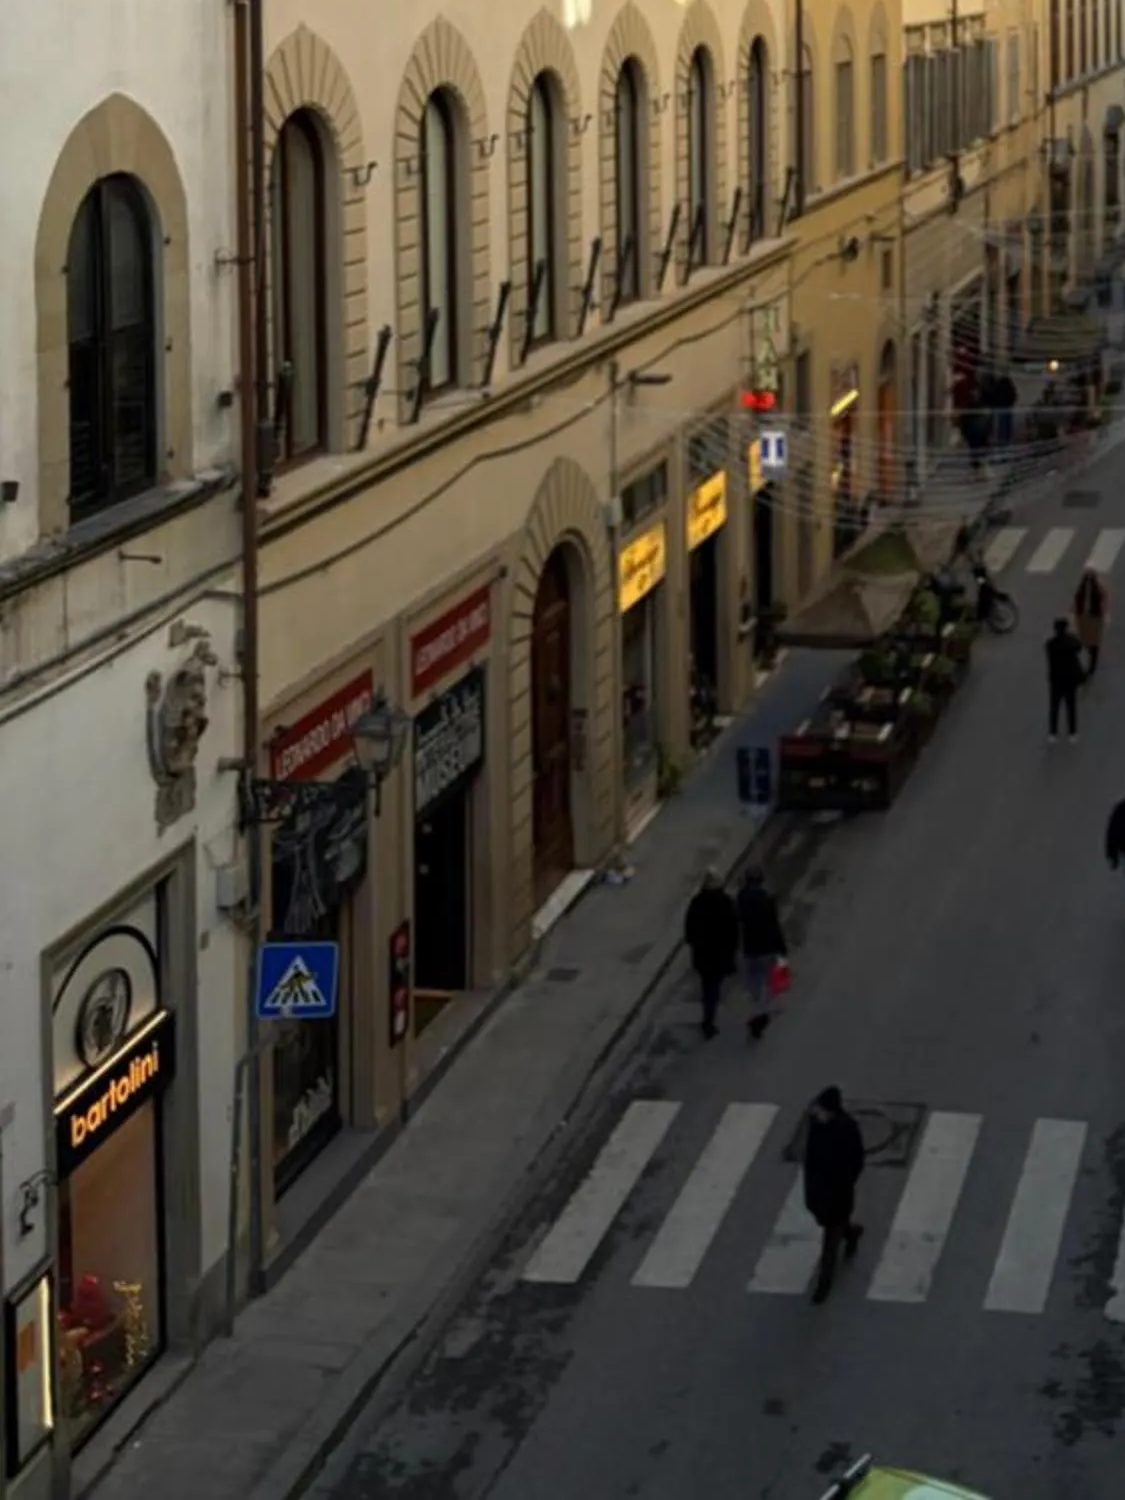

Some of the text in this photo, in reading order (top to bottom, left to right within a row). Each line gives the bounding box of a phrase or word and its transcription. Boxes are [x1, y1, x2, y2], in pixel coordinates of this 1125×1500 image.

[276, 719, 330, 780] LEONARDO
[331, 708, 346, 740] DA
[71, 1041, 159, 1148] bartolini
